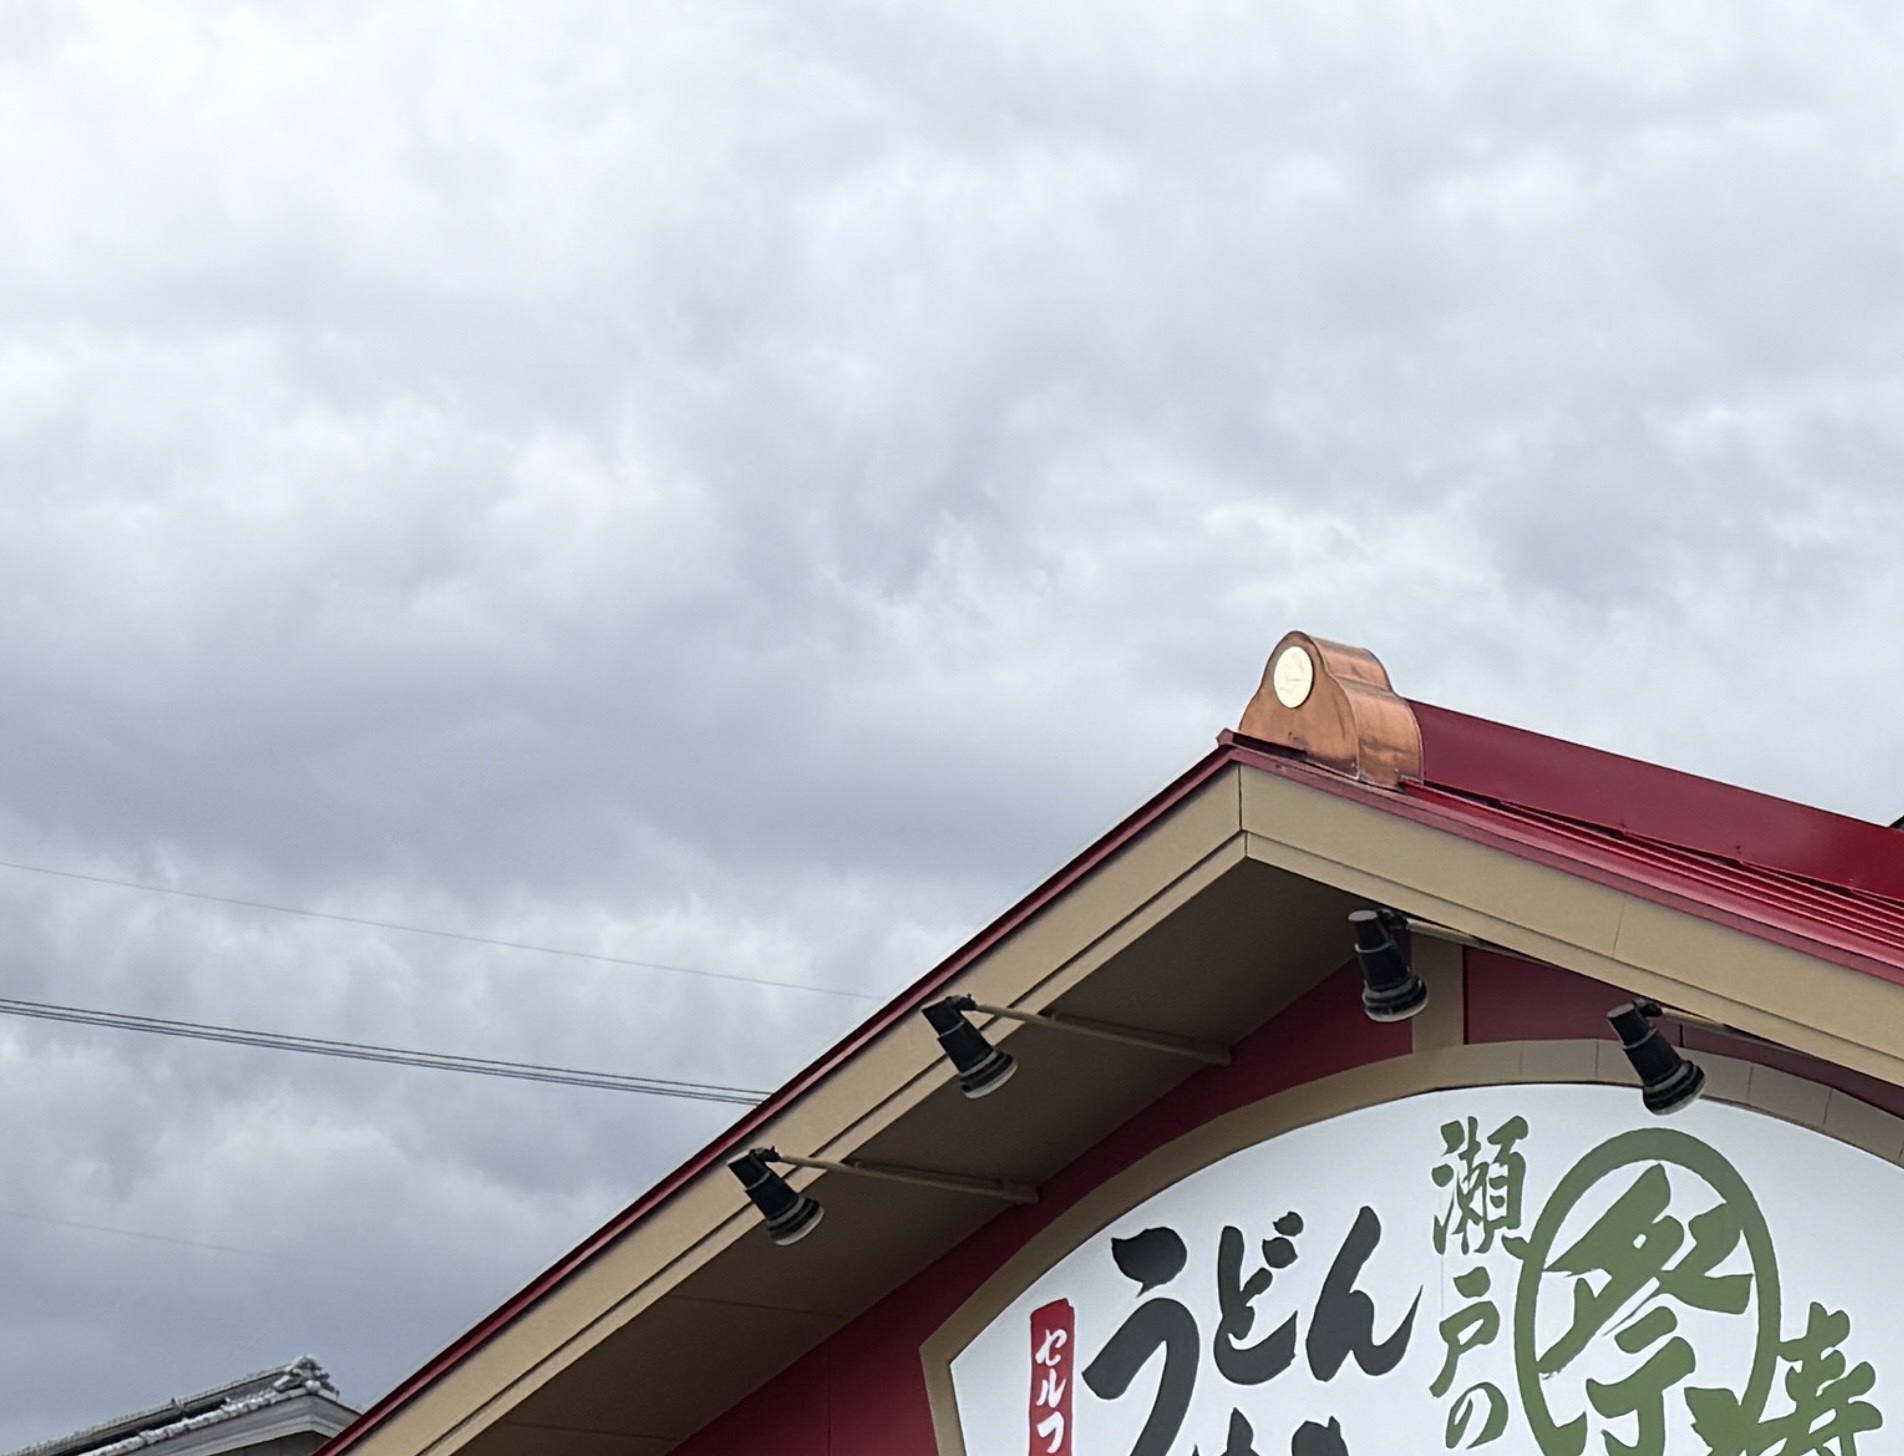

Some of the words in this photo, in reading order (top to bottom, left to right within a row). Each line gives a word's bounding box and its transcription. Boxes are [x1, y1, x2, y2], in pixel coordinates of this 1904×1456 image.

[1034, 1328, 1069, 1455] セルフ
[1431, 1115, 1528, 1452] 瀬戸の
